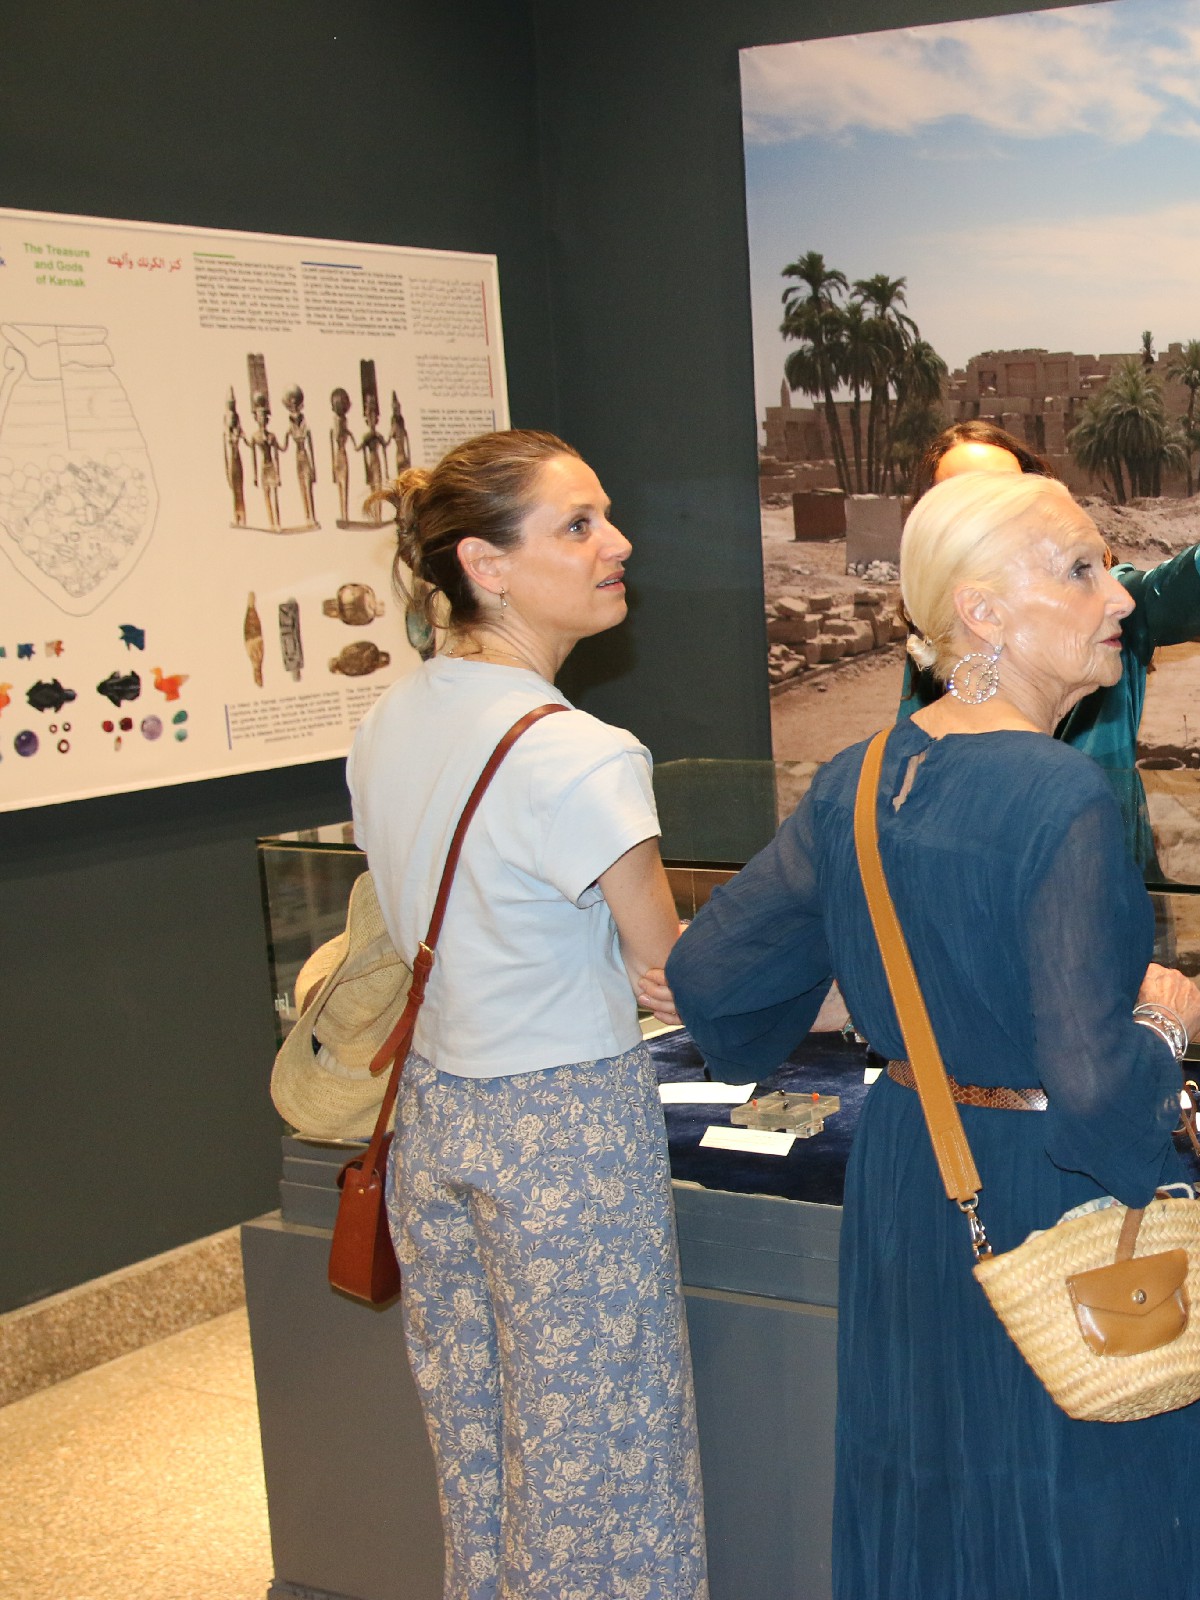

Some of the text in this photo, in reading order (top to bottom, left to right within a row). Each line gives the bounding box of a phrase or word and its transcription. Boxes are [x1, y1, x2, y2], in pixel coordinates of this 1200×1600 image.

[23, 242, 91, 258] The Treasure
[34, 260, 84, 272] and Gods
[36, 275, 86, 287] of Karnak
